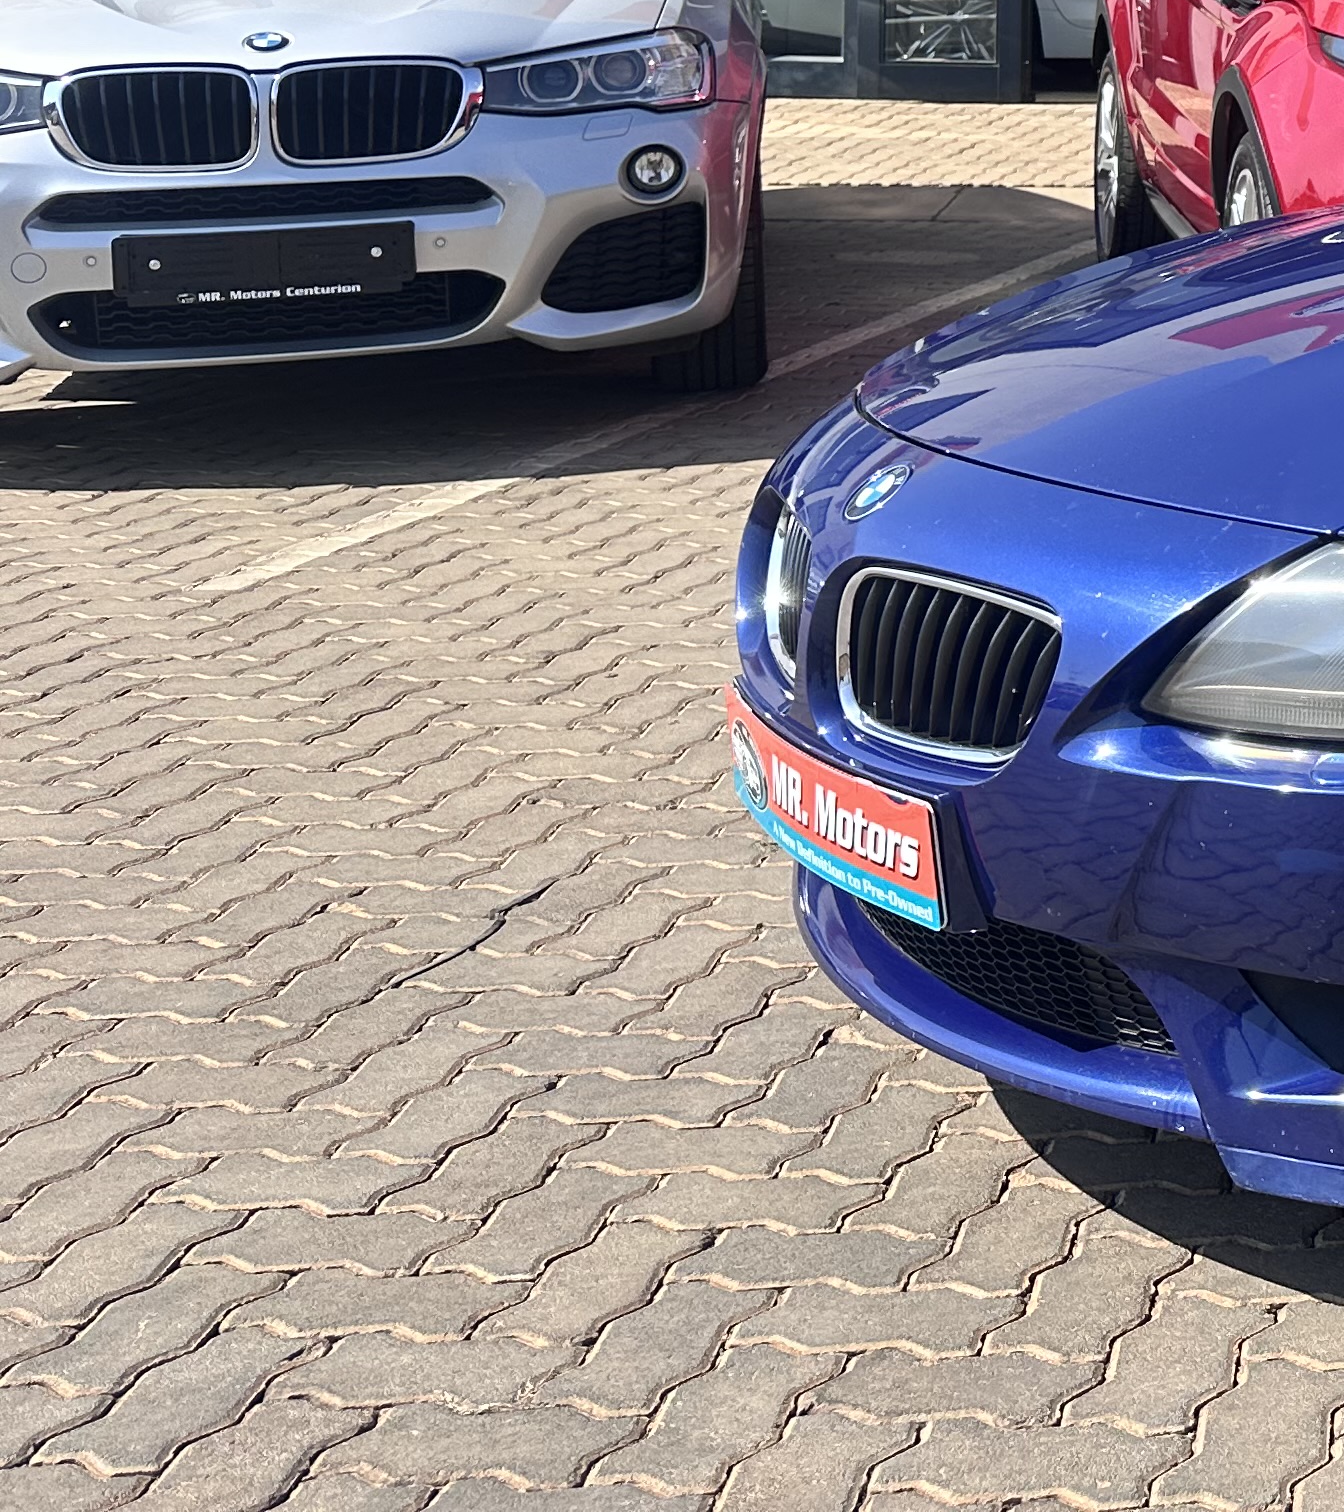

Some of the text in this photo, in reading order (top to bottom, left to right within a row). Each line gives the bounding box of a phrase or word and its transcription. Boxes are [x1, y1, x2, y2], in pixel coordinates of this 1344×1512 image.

[199, 283, 362, 303] MR. Motors Centurion
[771, 753, 810, 830] MR.
[813, 782, 921, 881] Motors
[797, 839, 847, 887] Definition
[847, 872, 862, 891] to
[863, 877, 933, 923] Pre-Owned
